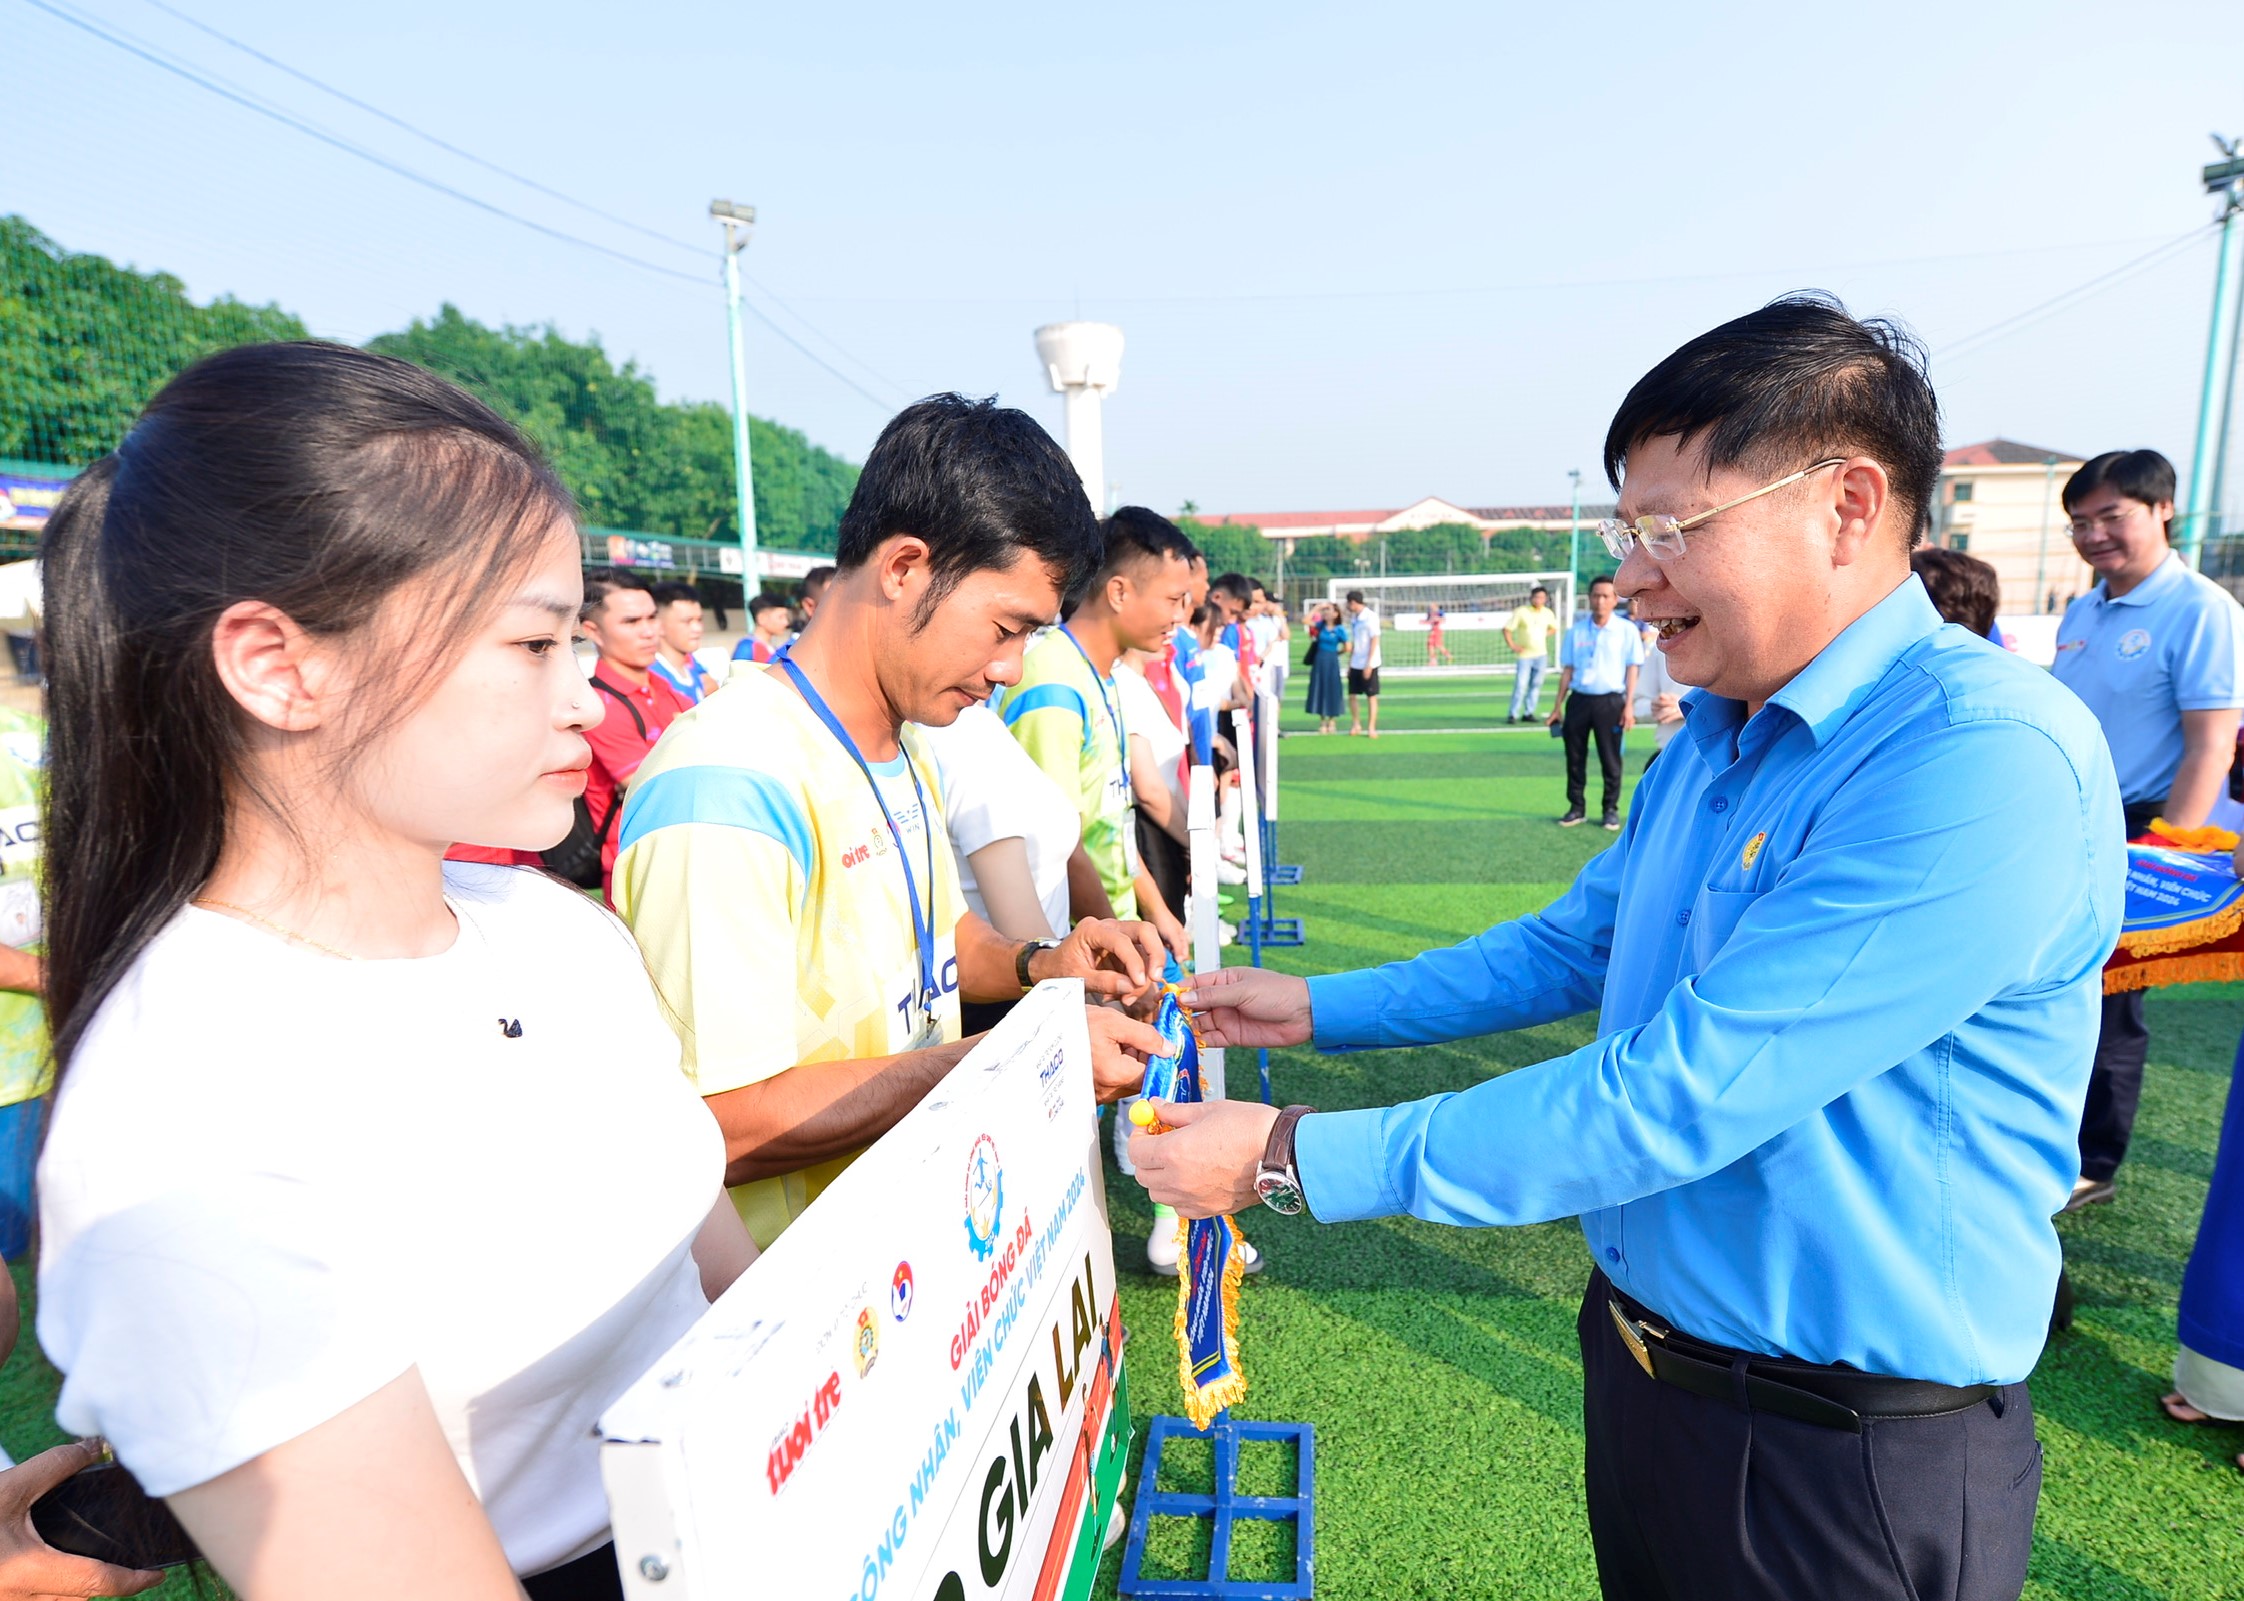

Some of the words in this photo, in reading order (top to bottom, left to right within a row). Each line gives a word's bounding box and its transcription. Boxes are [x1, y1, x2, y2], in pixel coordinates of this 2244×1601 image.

[1040, 1048, 1064, 1088] THACO
[850, 1504, 908, 1601] ÔNG
[908, 1406, 962, 1519] NHÂN,
[961, 1338, 994, 1412] VIÊN
[994, 1276, 1026, 1352] CHỨC
[1025, 1234, 1047, 1290] VIỆT
[1046, 1198, 1067, 1252] NAM
[950, 1301, 981, 1371] GIẢI
[981, 1241, 1016, 1320] BÓNG
[1016, 1206, 1033, 1257] ĐÁ
[978, 1370, 1054, 1588] GIA
[1052, 1250, 1098, 1417] LAI
